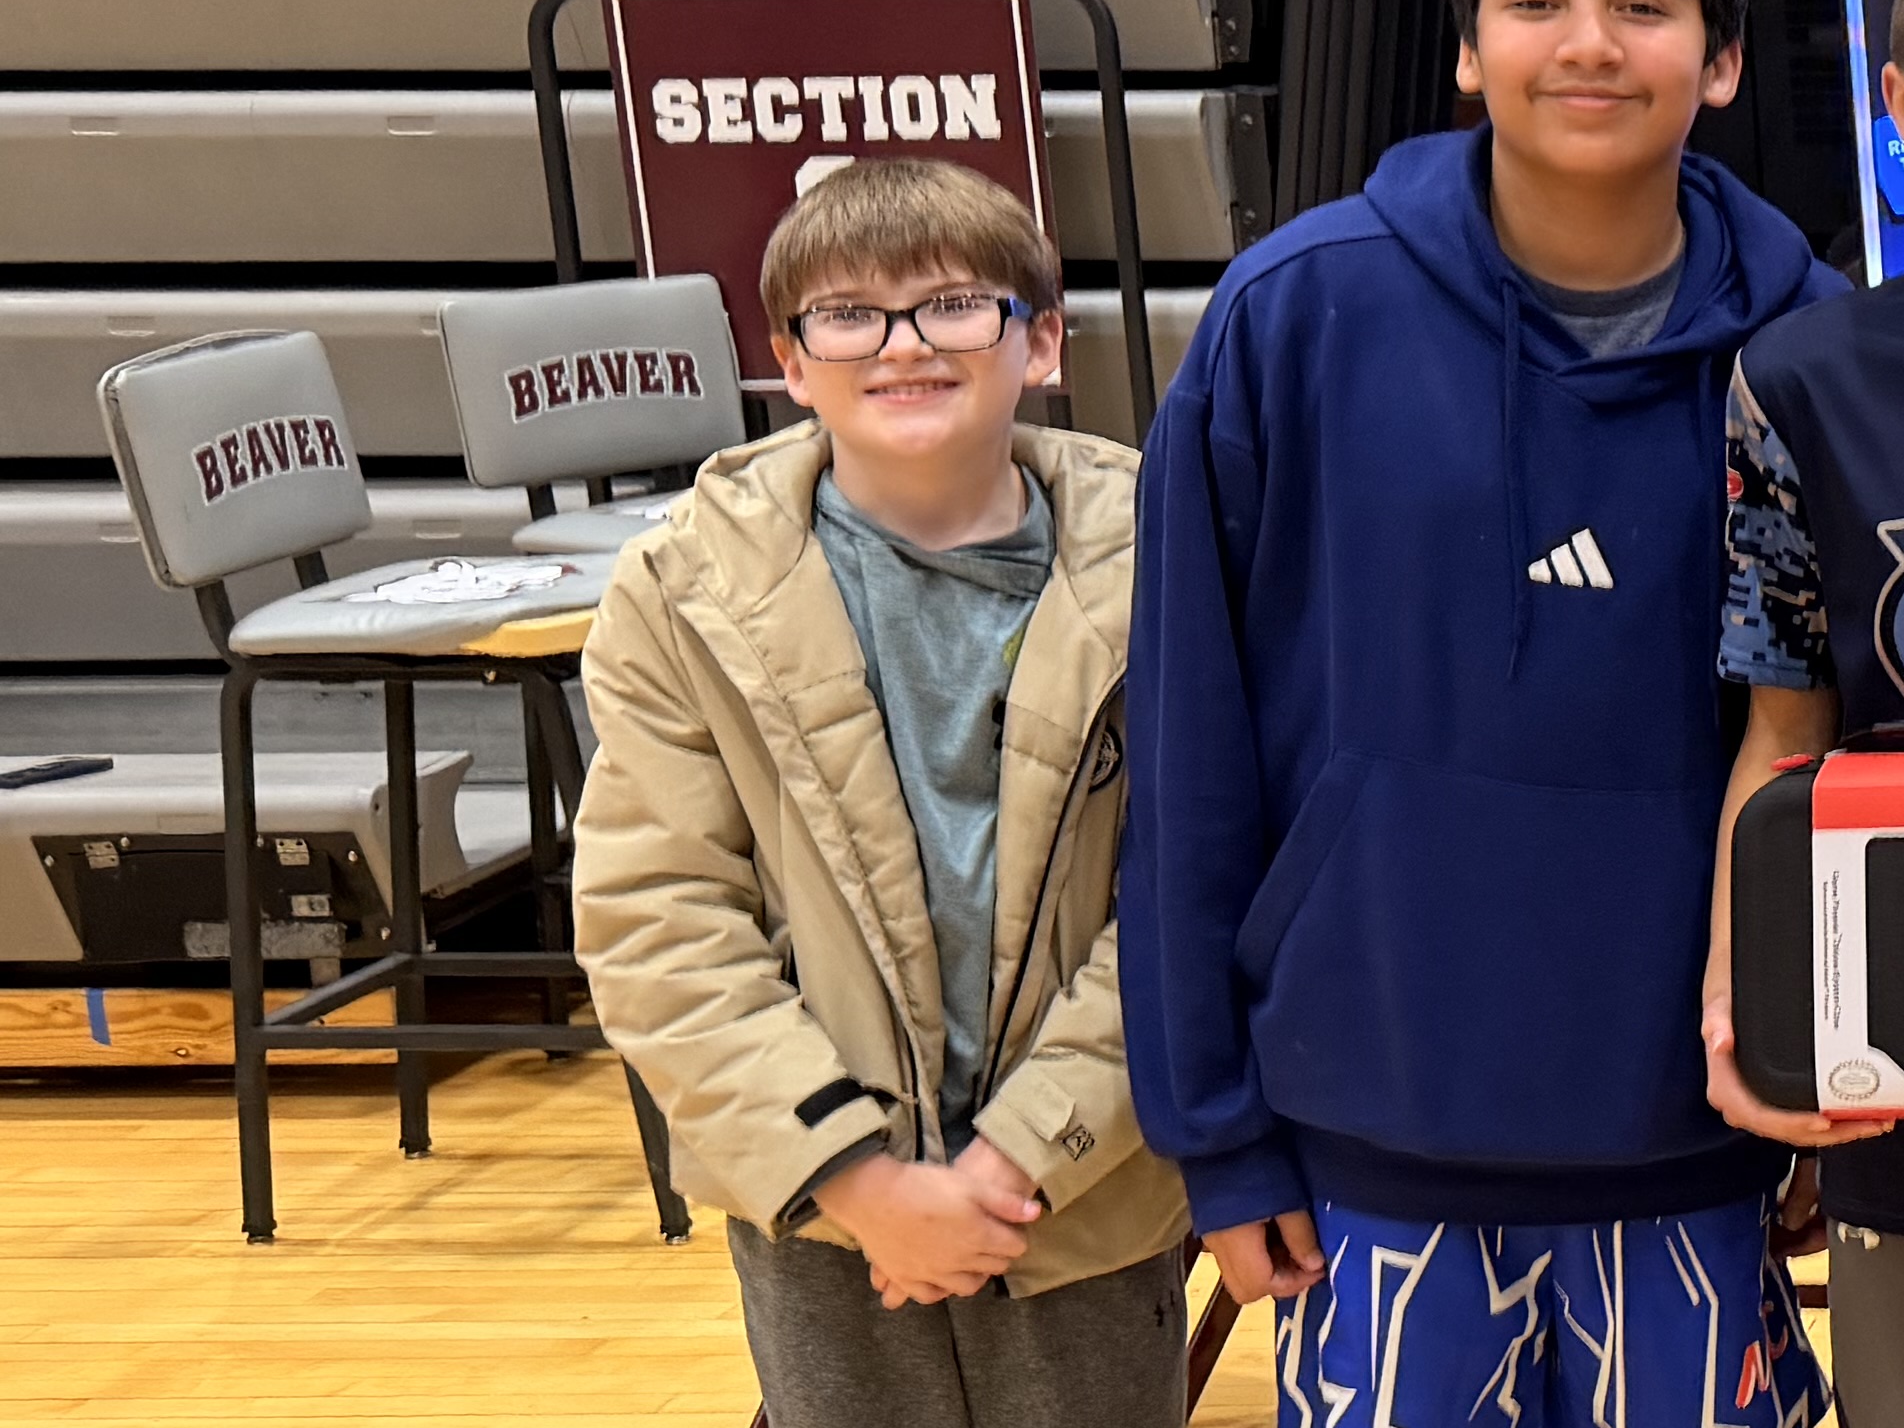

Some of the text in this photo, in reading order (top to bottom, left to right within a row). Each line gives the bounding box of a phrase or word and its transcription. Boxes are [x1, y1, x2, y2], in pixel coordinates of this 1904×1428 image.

[650, 73, 1001, 145] SECTION
[505, 347, 705, 423] BEAVER
[193, 413, 348, 506] BEAVER
